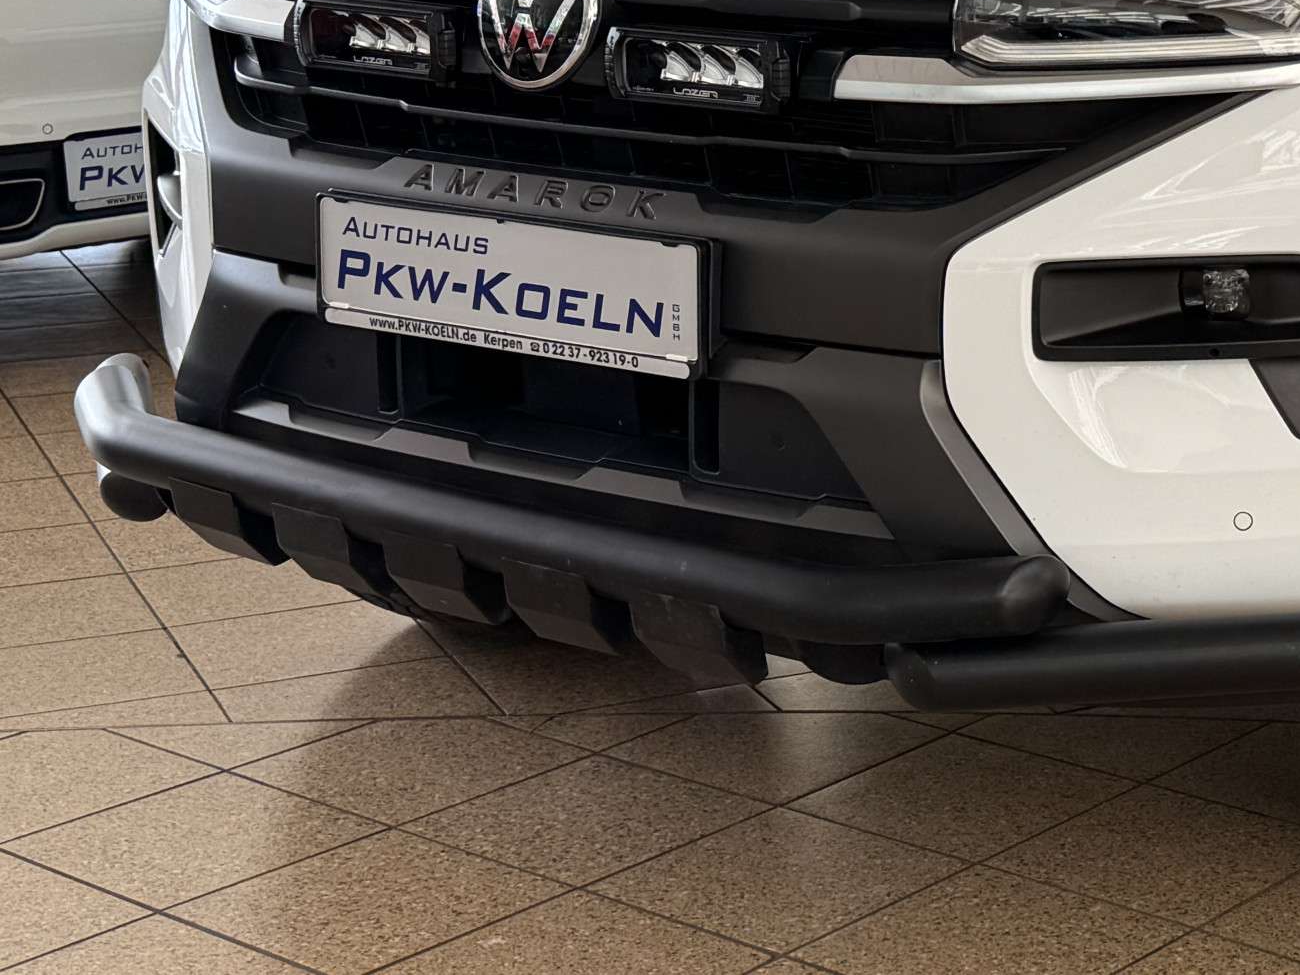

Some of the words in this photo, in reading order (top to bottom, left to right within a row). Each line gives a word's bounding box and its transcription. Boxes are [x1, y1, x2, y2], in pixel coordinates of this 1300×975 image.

[81, 143, 144, 160] AUTOH
[403, 163, 667, 221] AMAROK
[341, 215, 490, 256] AUTOHAUS
[337, 248, 665, 338] PKW-KOELN
[369, 316, 477, 343] www.PKW-KOELN.de
[483, 332, 523, 350] Kerpen
